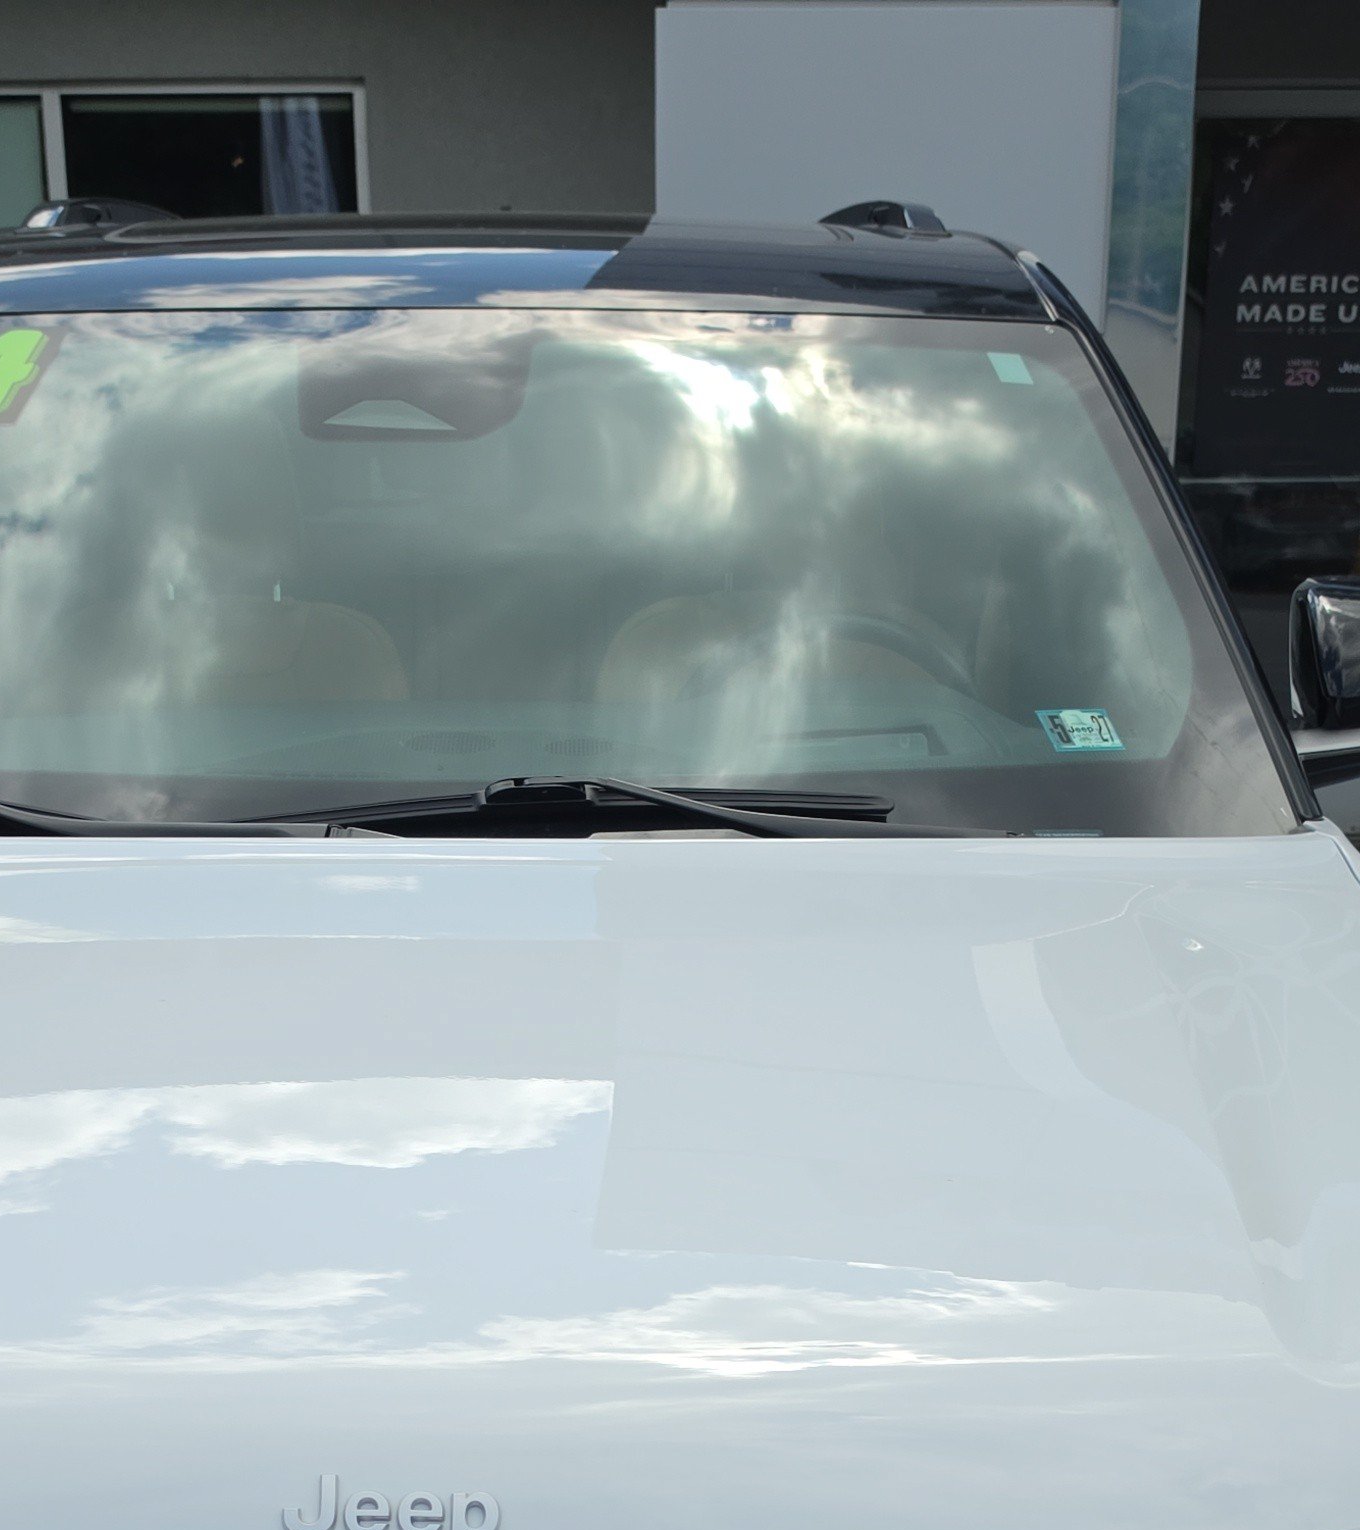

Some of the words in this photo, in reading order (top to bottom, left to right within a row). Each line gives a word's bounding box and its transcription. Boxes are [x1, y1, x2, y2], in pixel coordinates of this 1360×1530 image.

[1236, 303, 1327, 323] MADE
[1068, 725, 1094, 735] Jeep
[1090, 714, 1115, 742] 27
